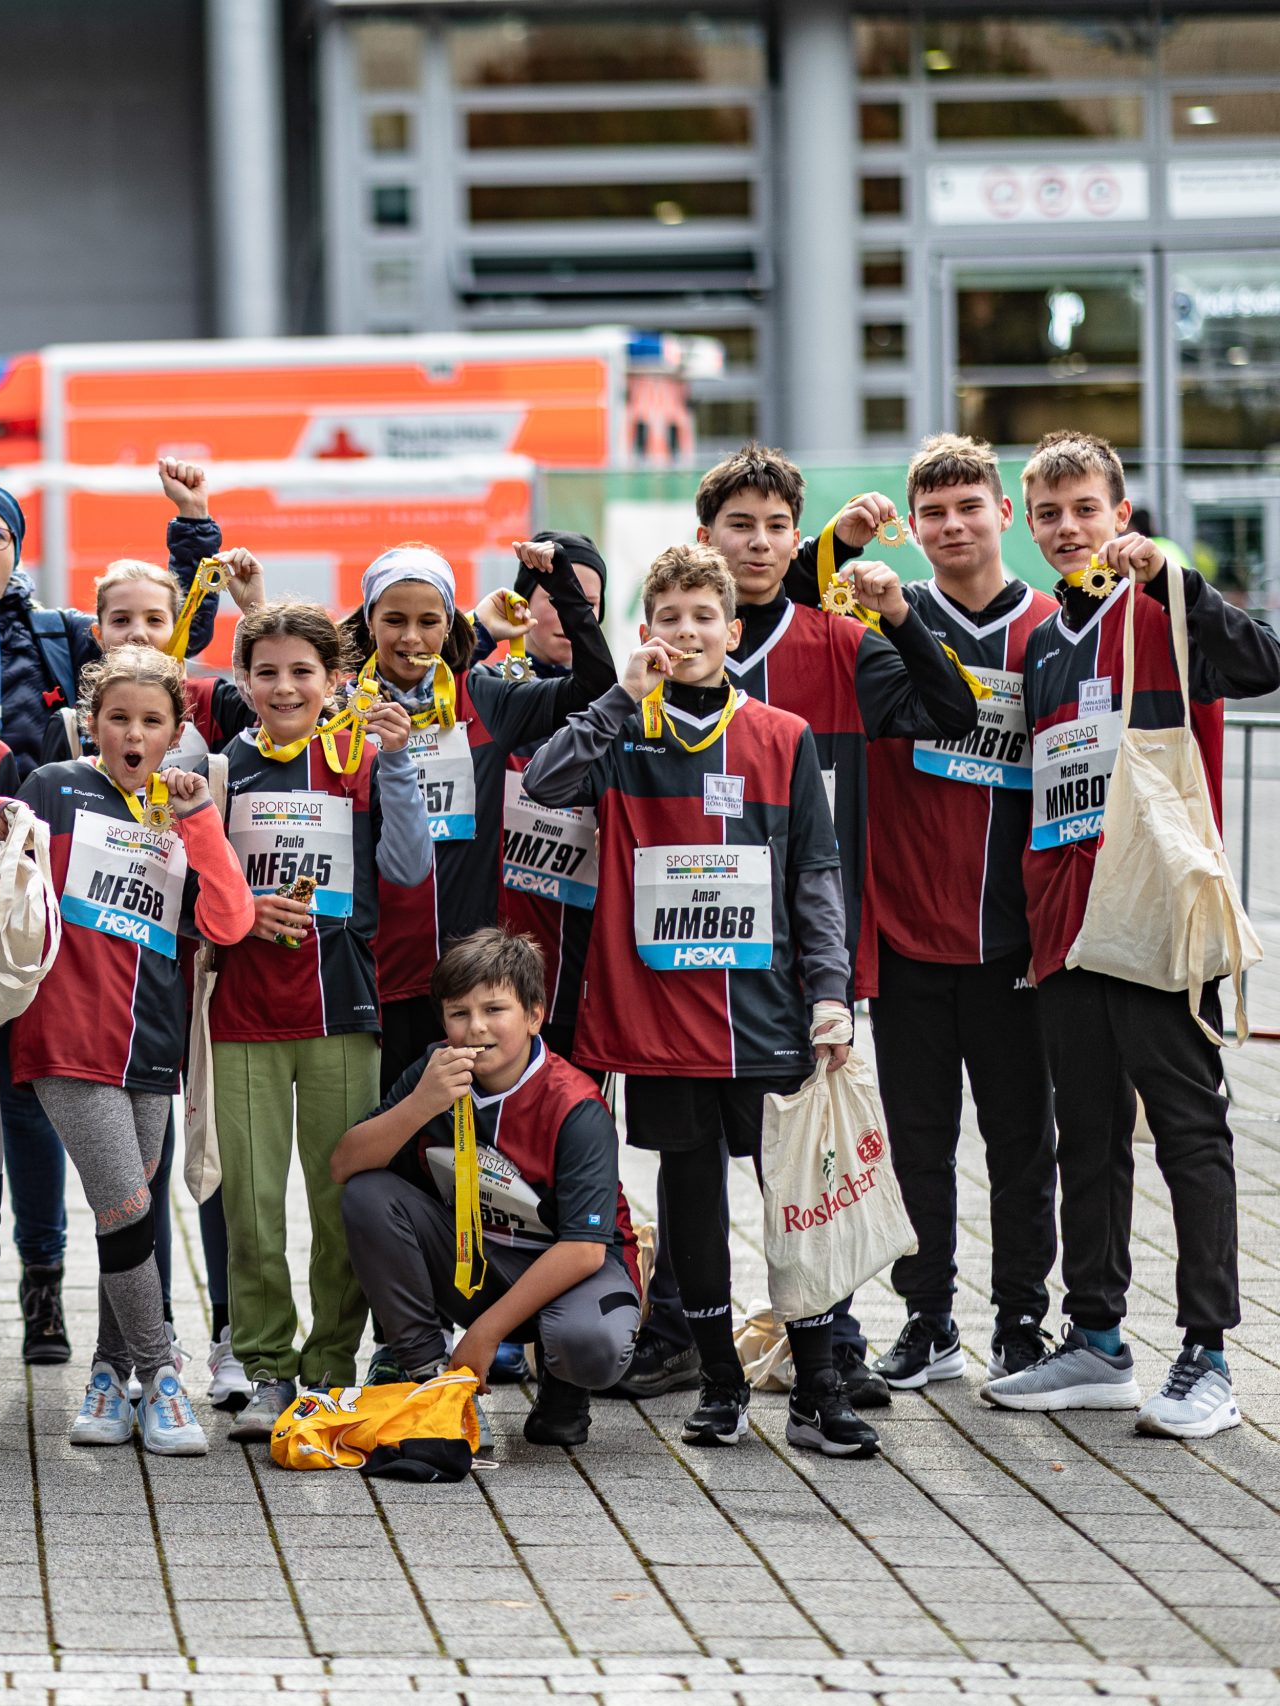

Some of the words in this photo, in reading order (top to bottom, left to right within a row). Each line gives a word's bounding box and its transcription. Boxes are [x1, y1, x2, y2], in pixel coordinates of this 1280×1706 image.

[977, 708, 1004, 724] axim
[1046, 725, 1098, 748] SPORTSTADT
[946, 760, 1004, 784] HOKA
[1060, 762, 1089, 780] Matteo
[251, 801, 323, 815] SPORTSTADT
[705, 795, 742, 803] GYMNASIUM
[106, 825, 174, 852] SPORTSTADT
[532, 819, 564, 837] Simon
[1059, 814, 1104, 842] HOKA
[275, 834, 304, 848] Paula
[104, 842, 142, 856] FRANKFURT
[155, 854, 166, 864] MAIN
[503, 829, 587, 876] MM797
[666, 854, 740, 867] SPORTSTADT
[128, 861, 147, 877] Lisa
[246, 853, 332, 887] MF545
[504, 868, 560, 897] HOKA
[87, 870, 164, 921] MF558
[692, 889, 720, 902] Amar
[95, 910, 151, 944] HOKA
[653, 906, 755, 940] MM868
[674, 946, 737, 967] HOKA
[477, 1153, 517, 1179] RTSTADT
[484, 1176, 493, 1184] AM
[495, 1181, 510, 1190] MAIN
